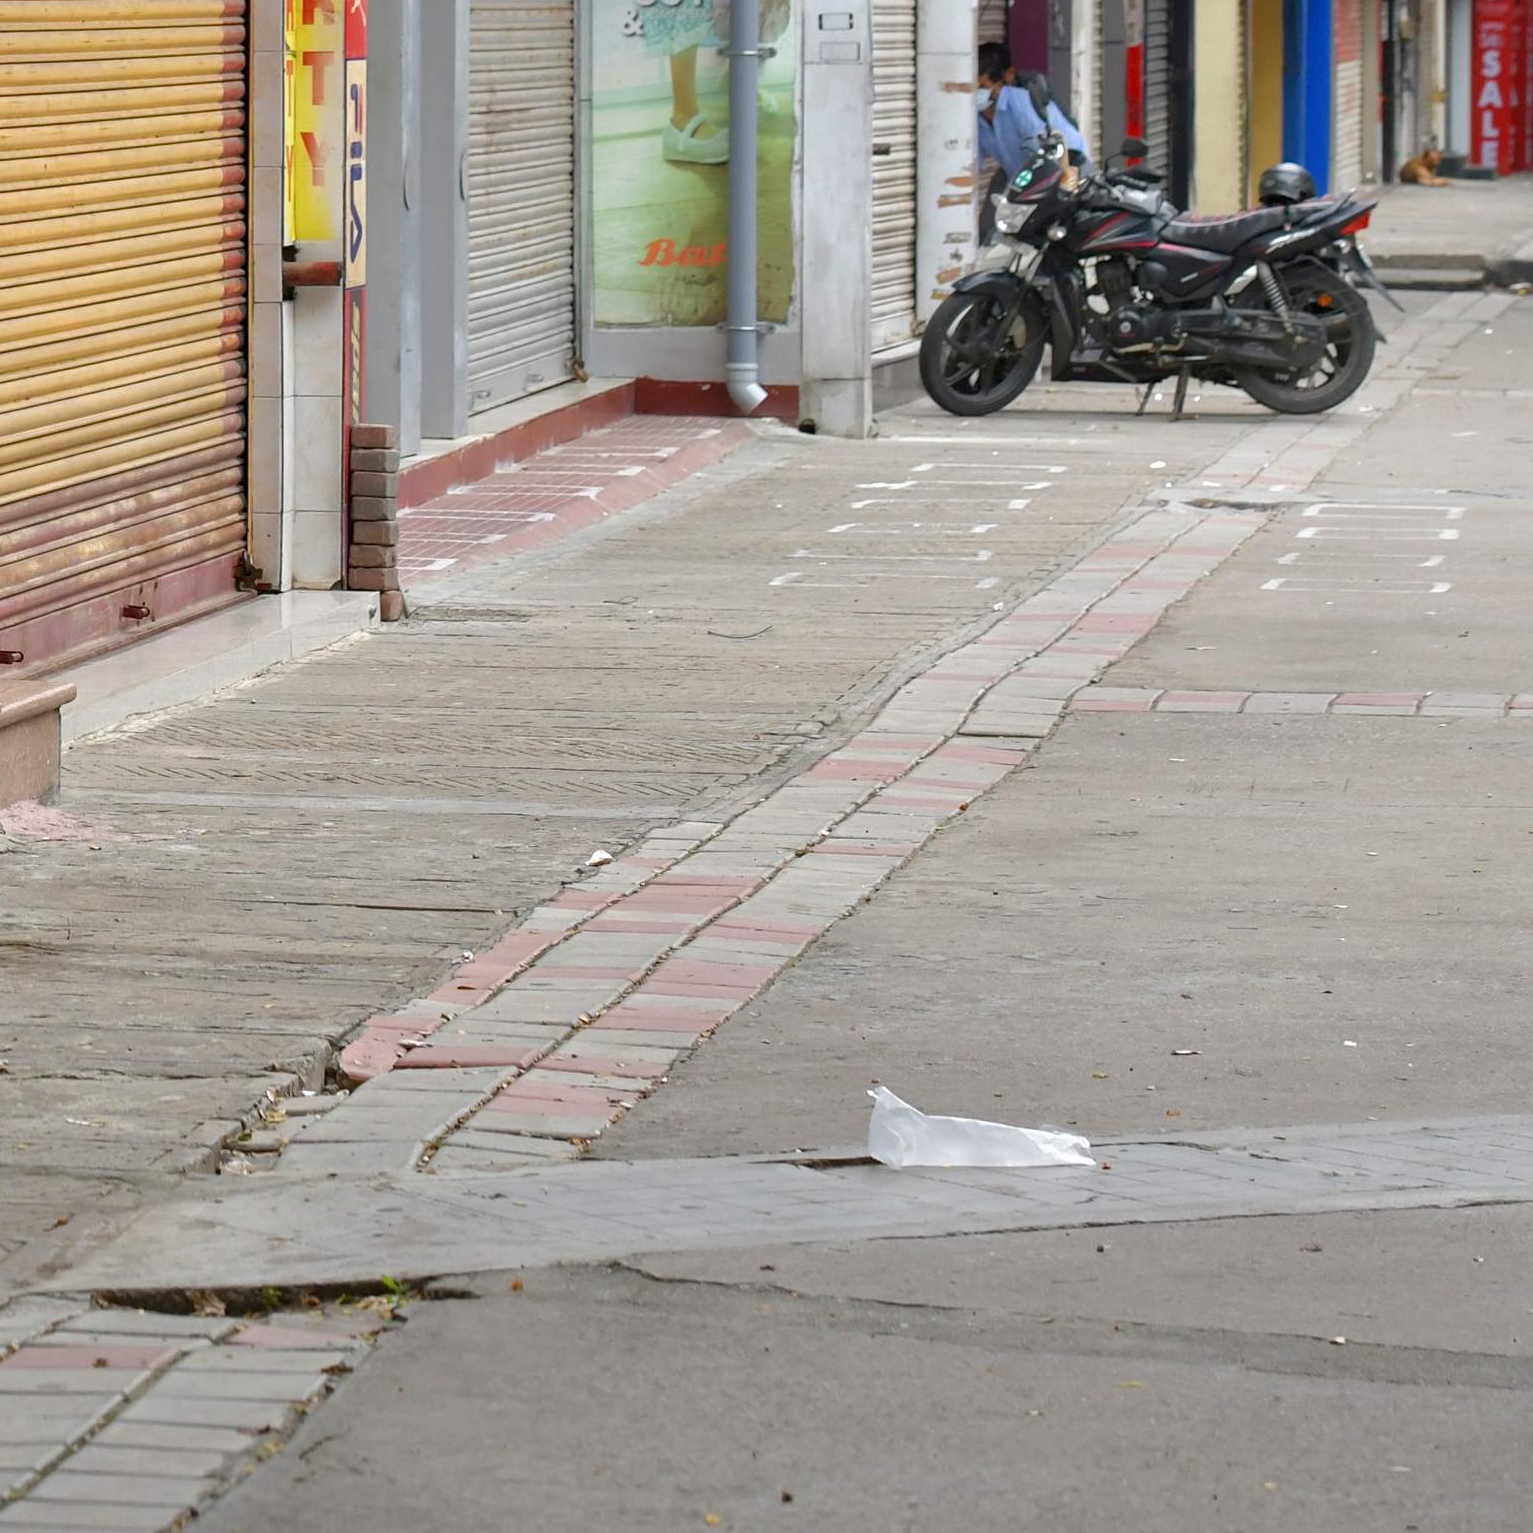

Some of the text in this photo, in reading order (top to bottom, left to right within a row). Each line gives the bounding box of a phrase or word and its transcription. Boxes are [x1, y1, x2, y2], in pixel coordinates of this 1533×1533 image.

[1477, 49, 1504, 170] SALE
[349, 82, 363, 264] FILA
[638, 237, 730, 267] Bat
